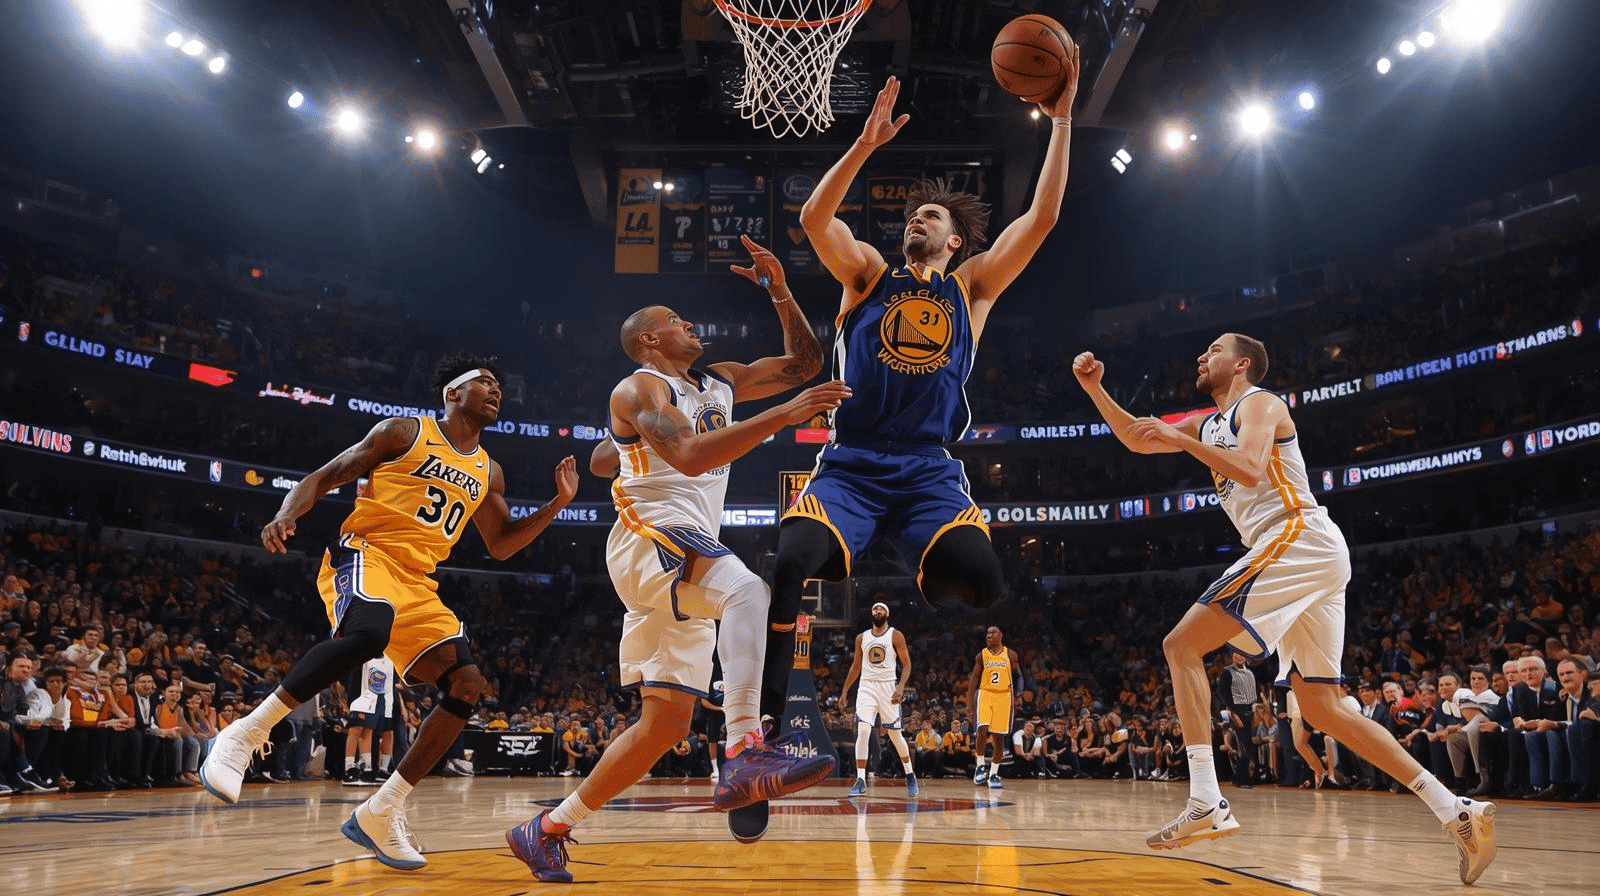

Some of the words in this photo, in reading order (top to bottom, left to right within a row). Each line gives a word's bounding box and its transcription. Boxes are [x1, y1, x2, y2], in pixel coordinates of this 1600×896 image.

[919, 310, 940, 326] 31
[1302, 378, 1362, 404] PARVELT
[410, 453, 482, 501] LAKERS
[416, 485, 466, 536] 30
[991, 672, 999, 684] 2
